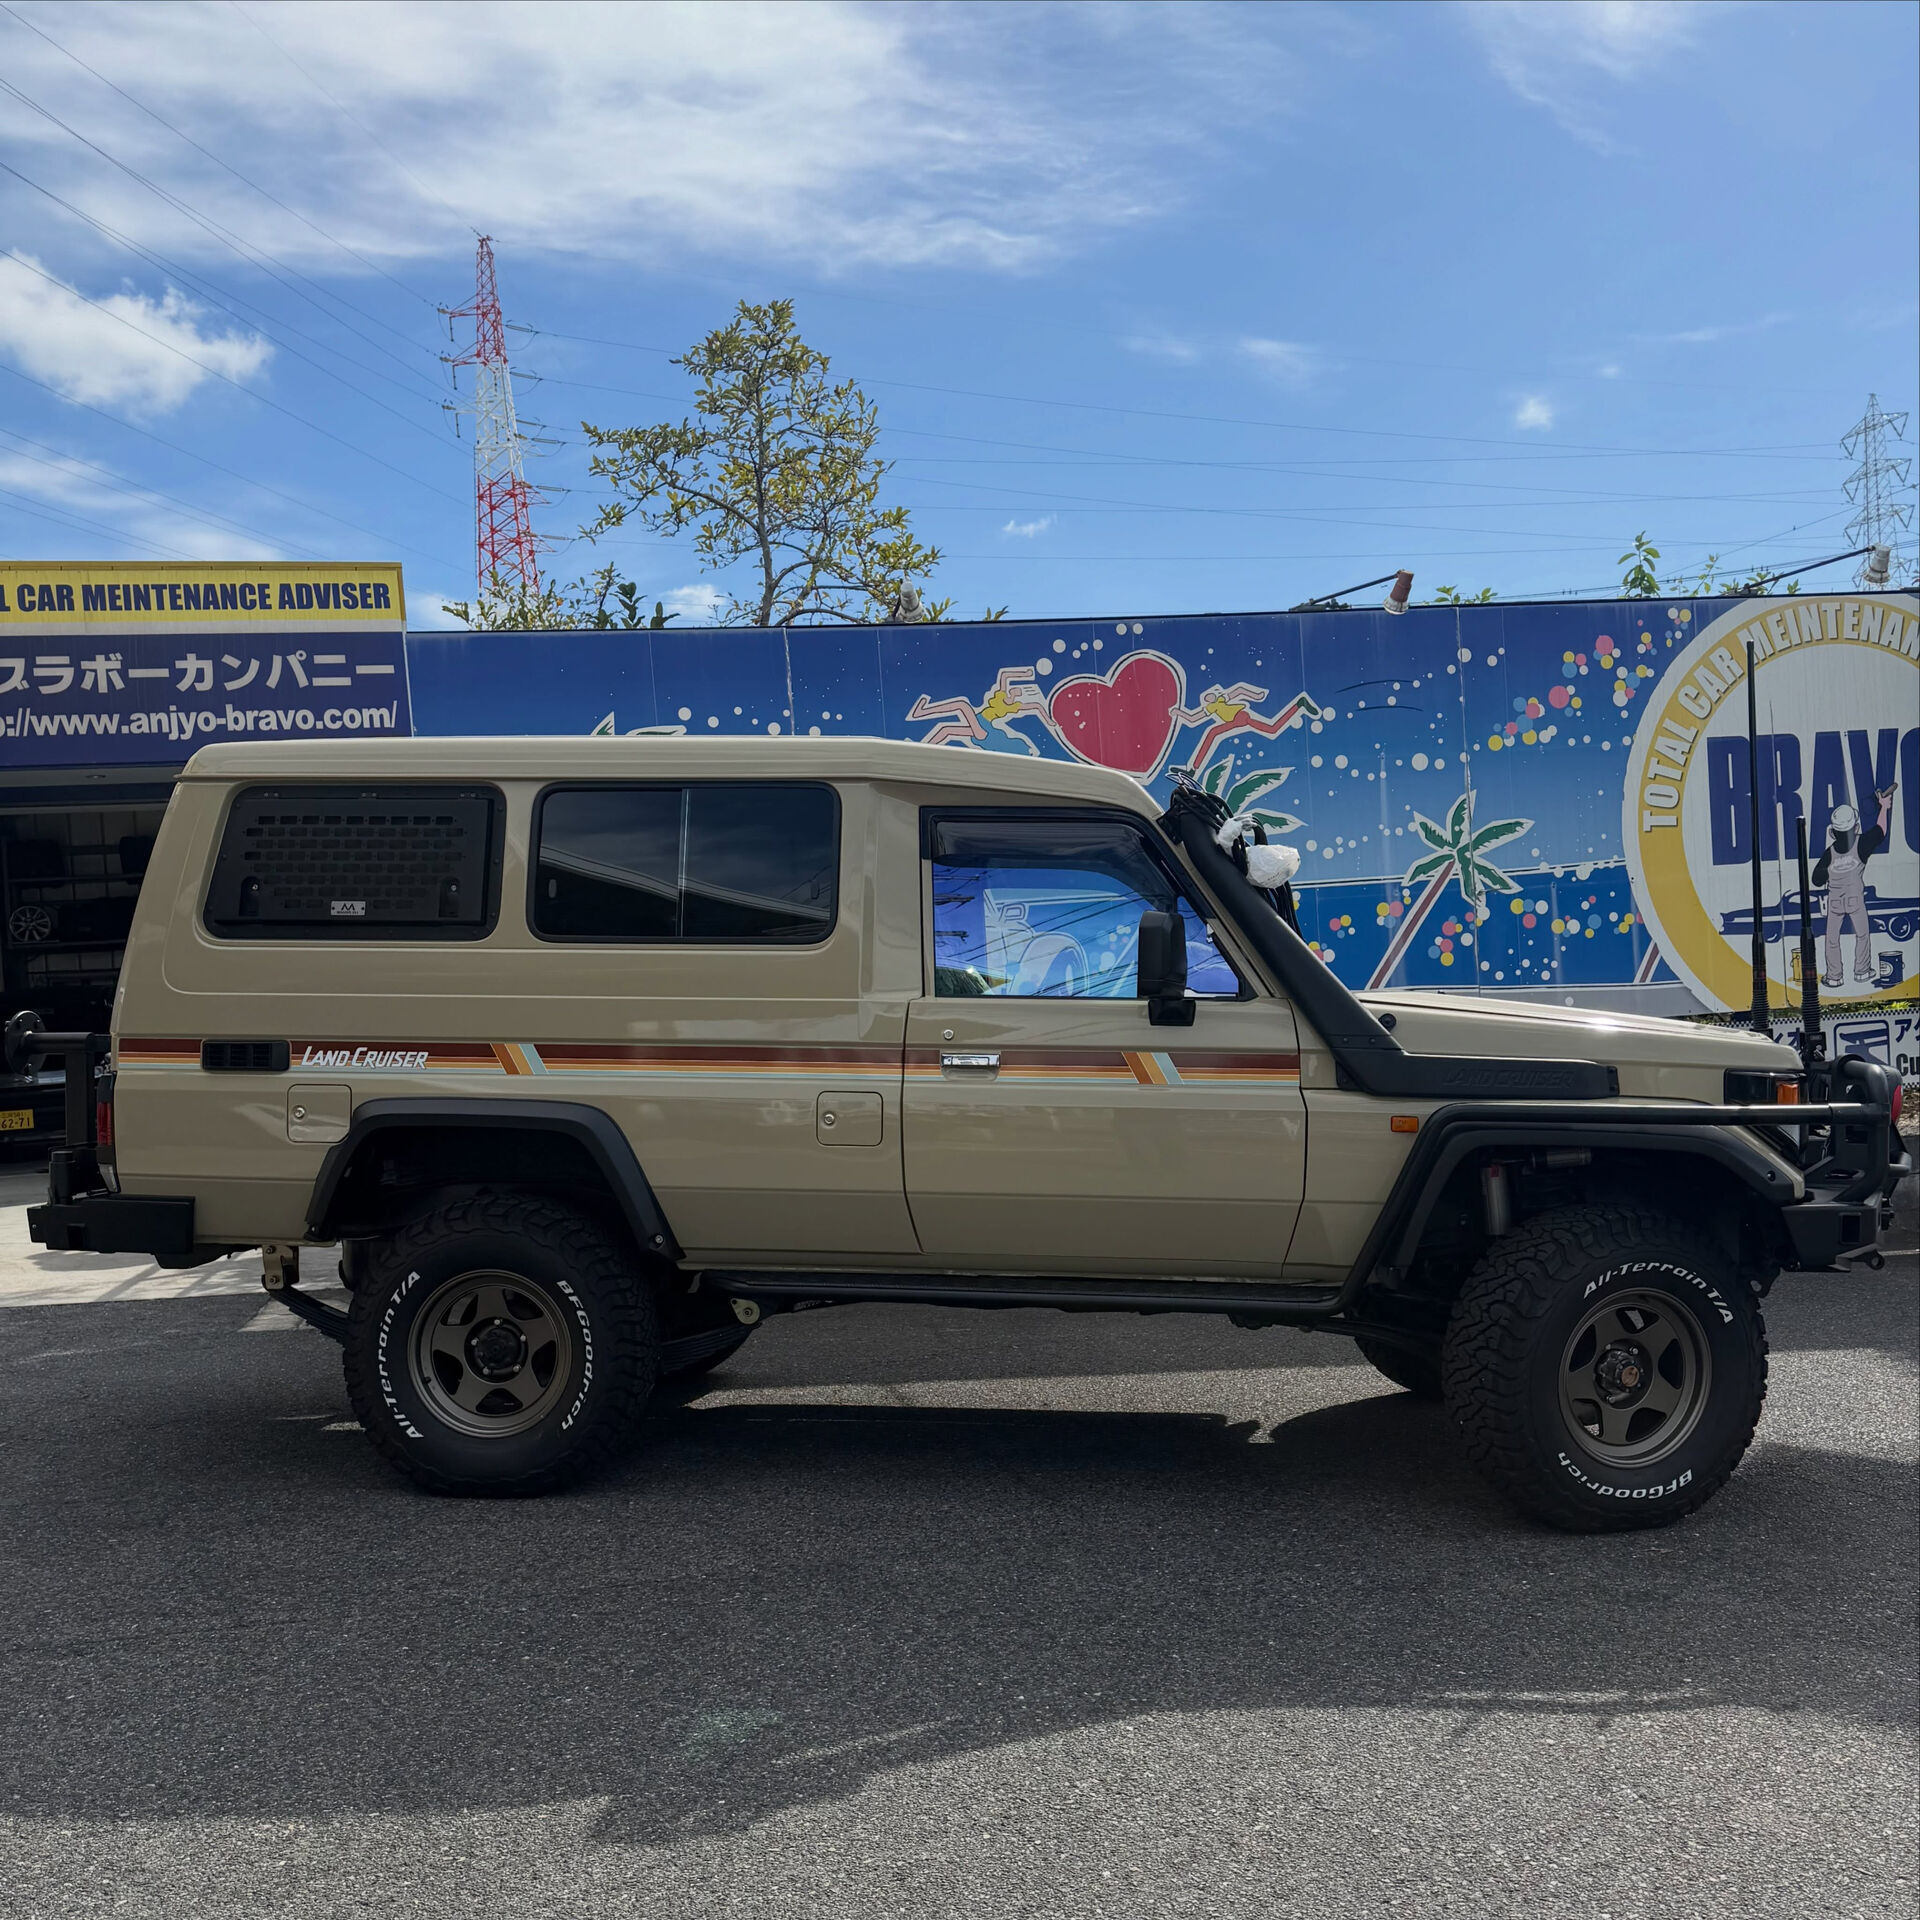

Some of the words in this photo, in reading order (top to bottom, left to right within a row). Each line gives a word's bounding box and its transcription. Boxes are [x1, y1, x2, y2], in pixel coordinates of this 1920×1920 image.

[17, 584, 74, 612] CAR
[82, 582, 271, 612] MEINTENANCE
[279, 582, 391, 610] ADVISER
[0, 700, 398, 740] ://www.anjyo-bravo.com/
[1642, 717, 1700, 833] TOTAL
[1677, 646, 1745, 720] CAR
[301, 1045, 351, 1067] LAND
[351, 1046, 429, 1070] CRUISER
[390, 1271, 421, 1305] T/A
[1583, 1262, 1707, 1299] All-Terrain
[1707, 1287, 1735, 1325] T/A
[378, 1308, 424, 1438] All-Terrain
[556, 1280, 594, 1431] BFGoodrich
[1557, 1452, 1693, 1499] BFGoodrich
